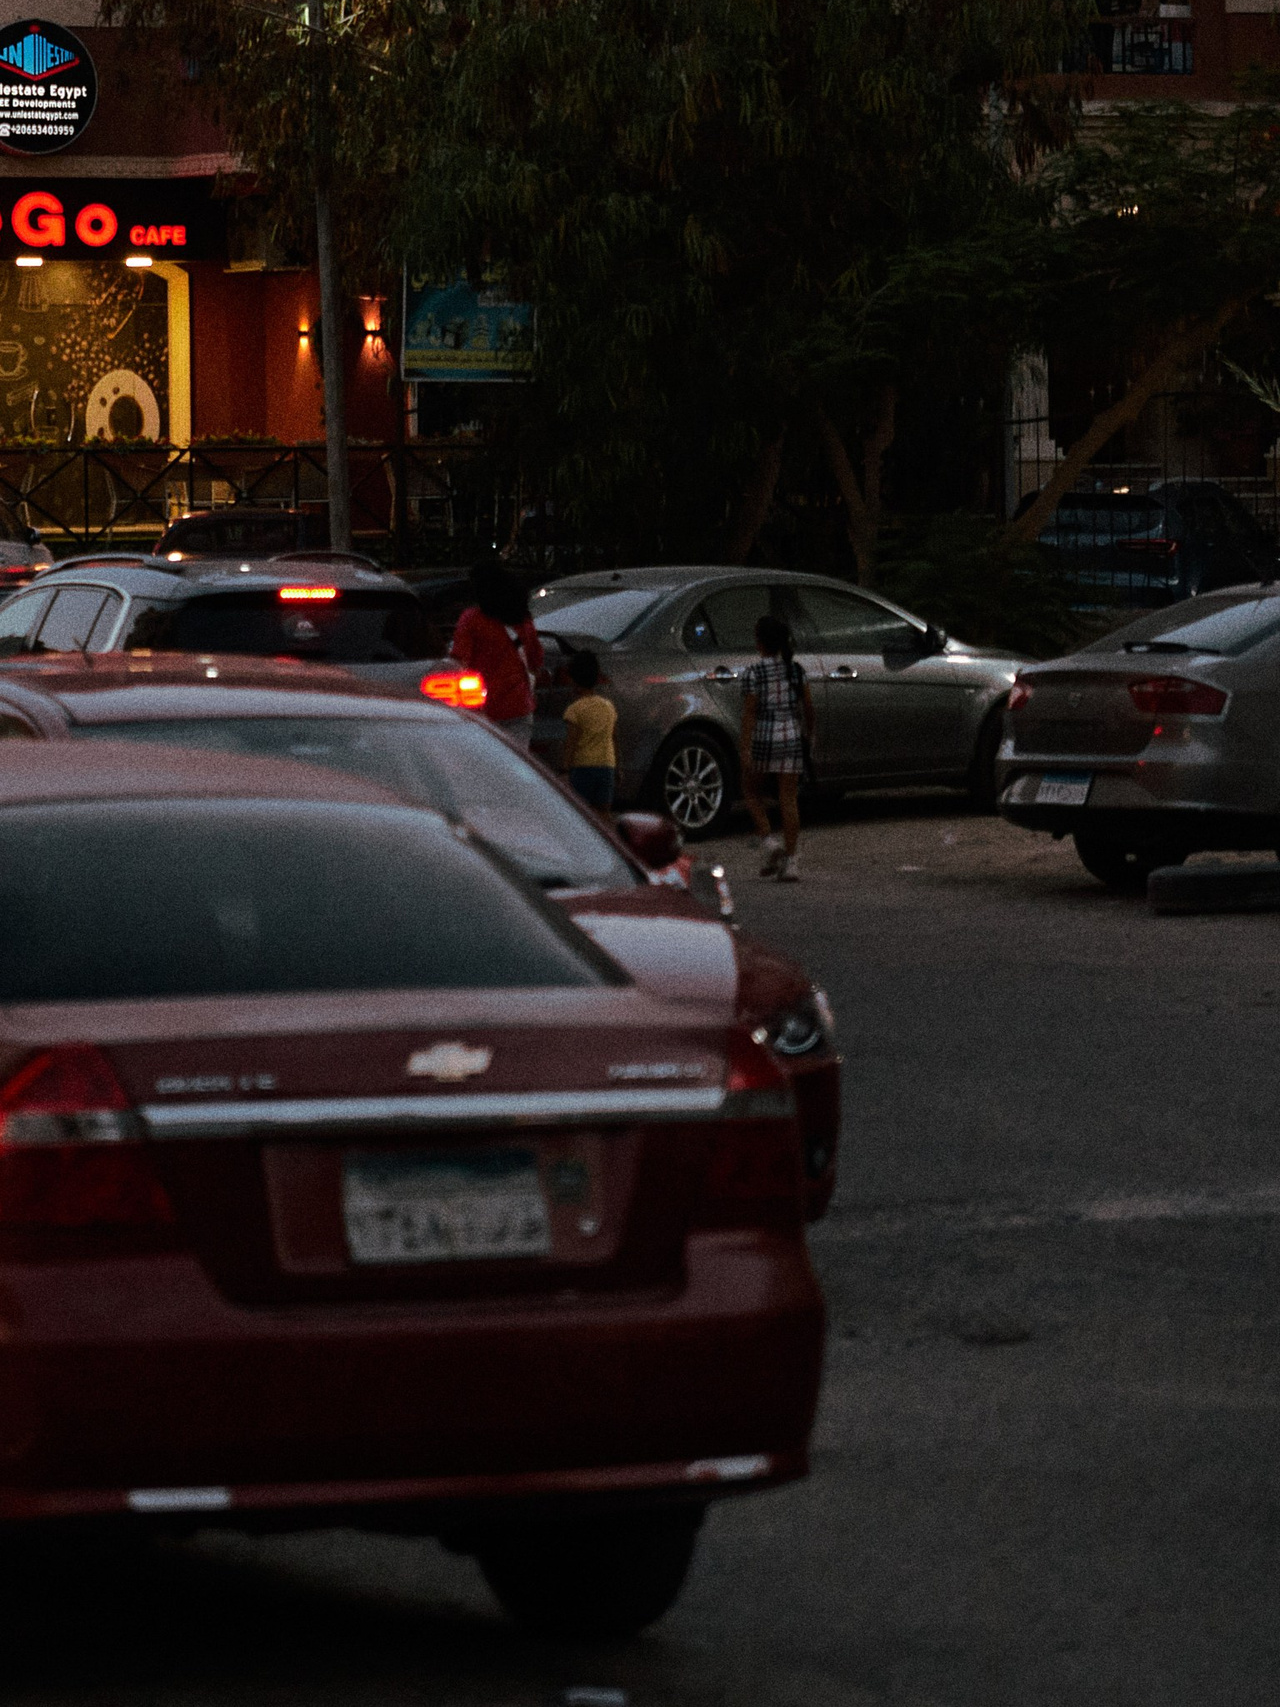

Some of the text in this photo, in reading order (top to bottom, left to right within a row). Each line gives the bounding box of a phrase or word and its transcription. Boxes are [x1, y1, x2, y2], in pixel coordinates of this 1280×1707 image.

[49, 84, 87, 100] Egypt
[12, 98, 77, 110] Developments
[129, 225, 187, 246] CAFE
